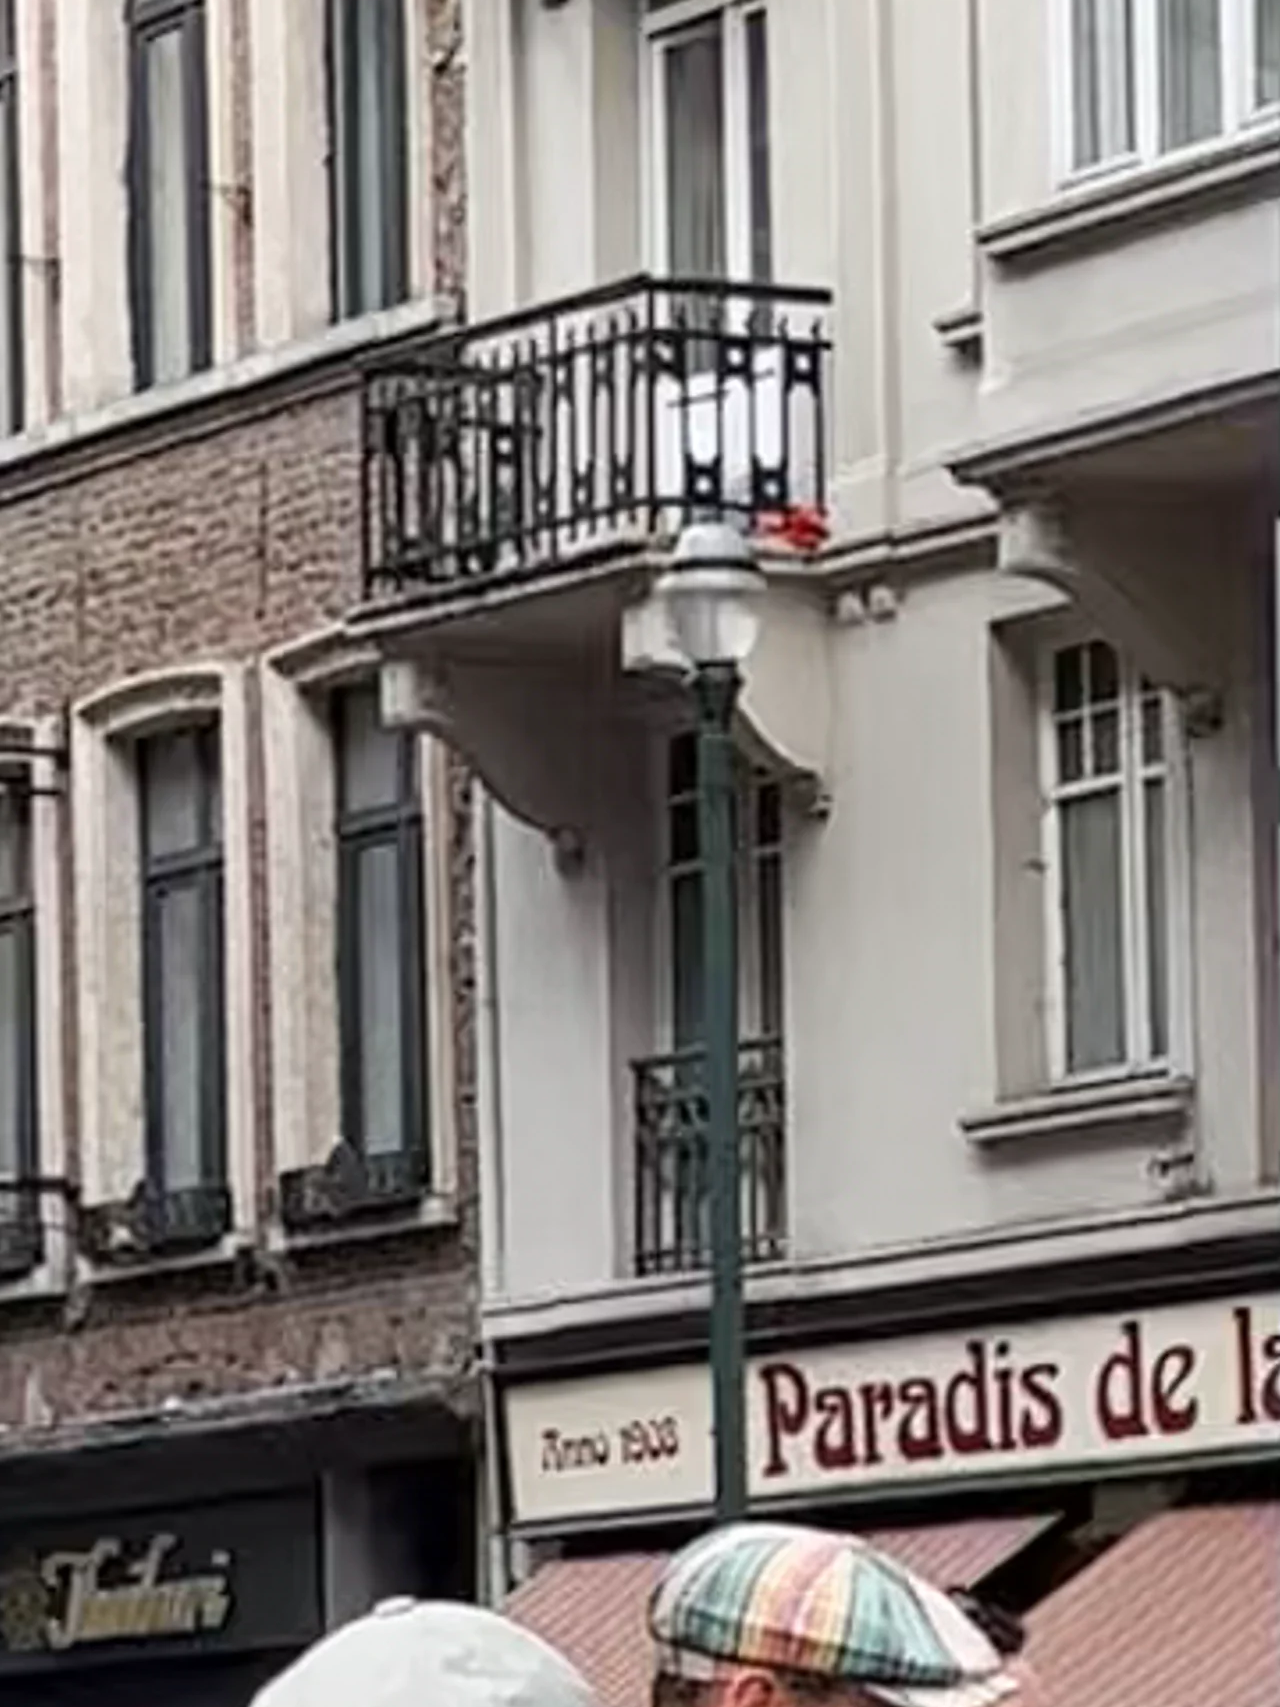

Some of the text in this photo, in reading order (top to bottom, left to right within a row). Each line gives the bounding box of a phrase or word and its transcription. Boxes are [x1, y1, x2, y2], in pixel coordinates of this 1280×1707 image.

[541, 1427, 610, 1473] Anno
[619, 1415, 680, 1465] 1908
[758, 1338, 1064, 1478] Paradis
[1096, 1319, 1199, 1440] de
